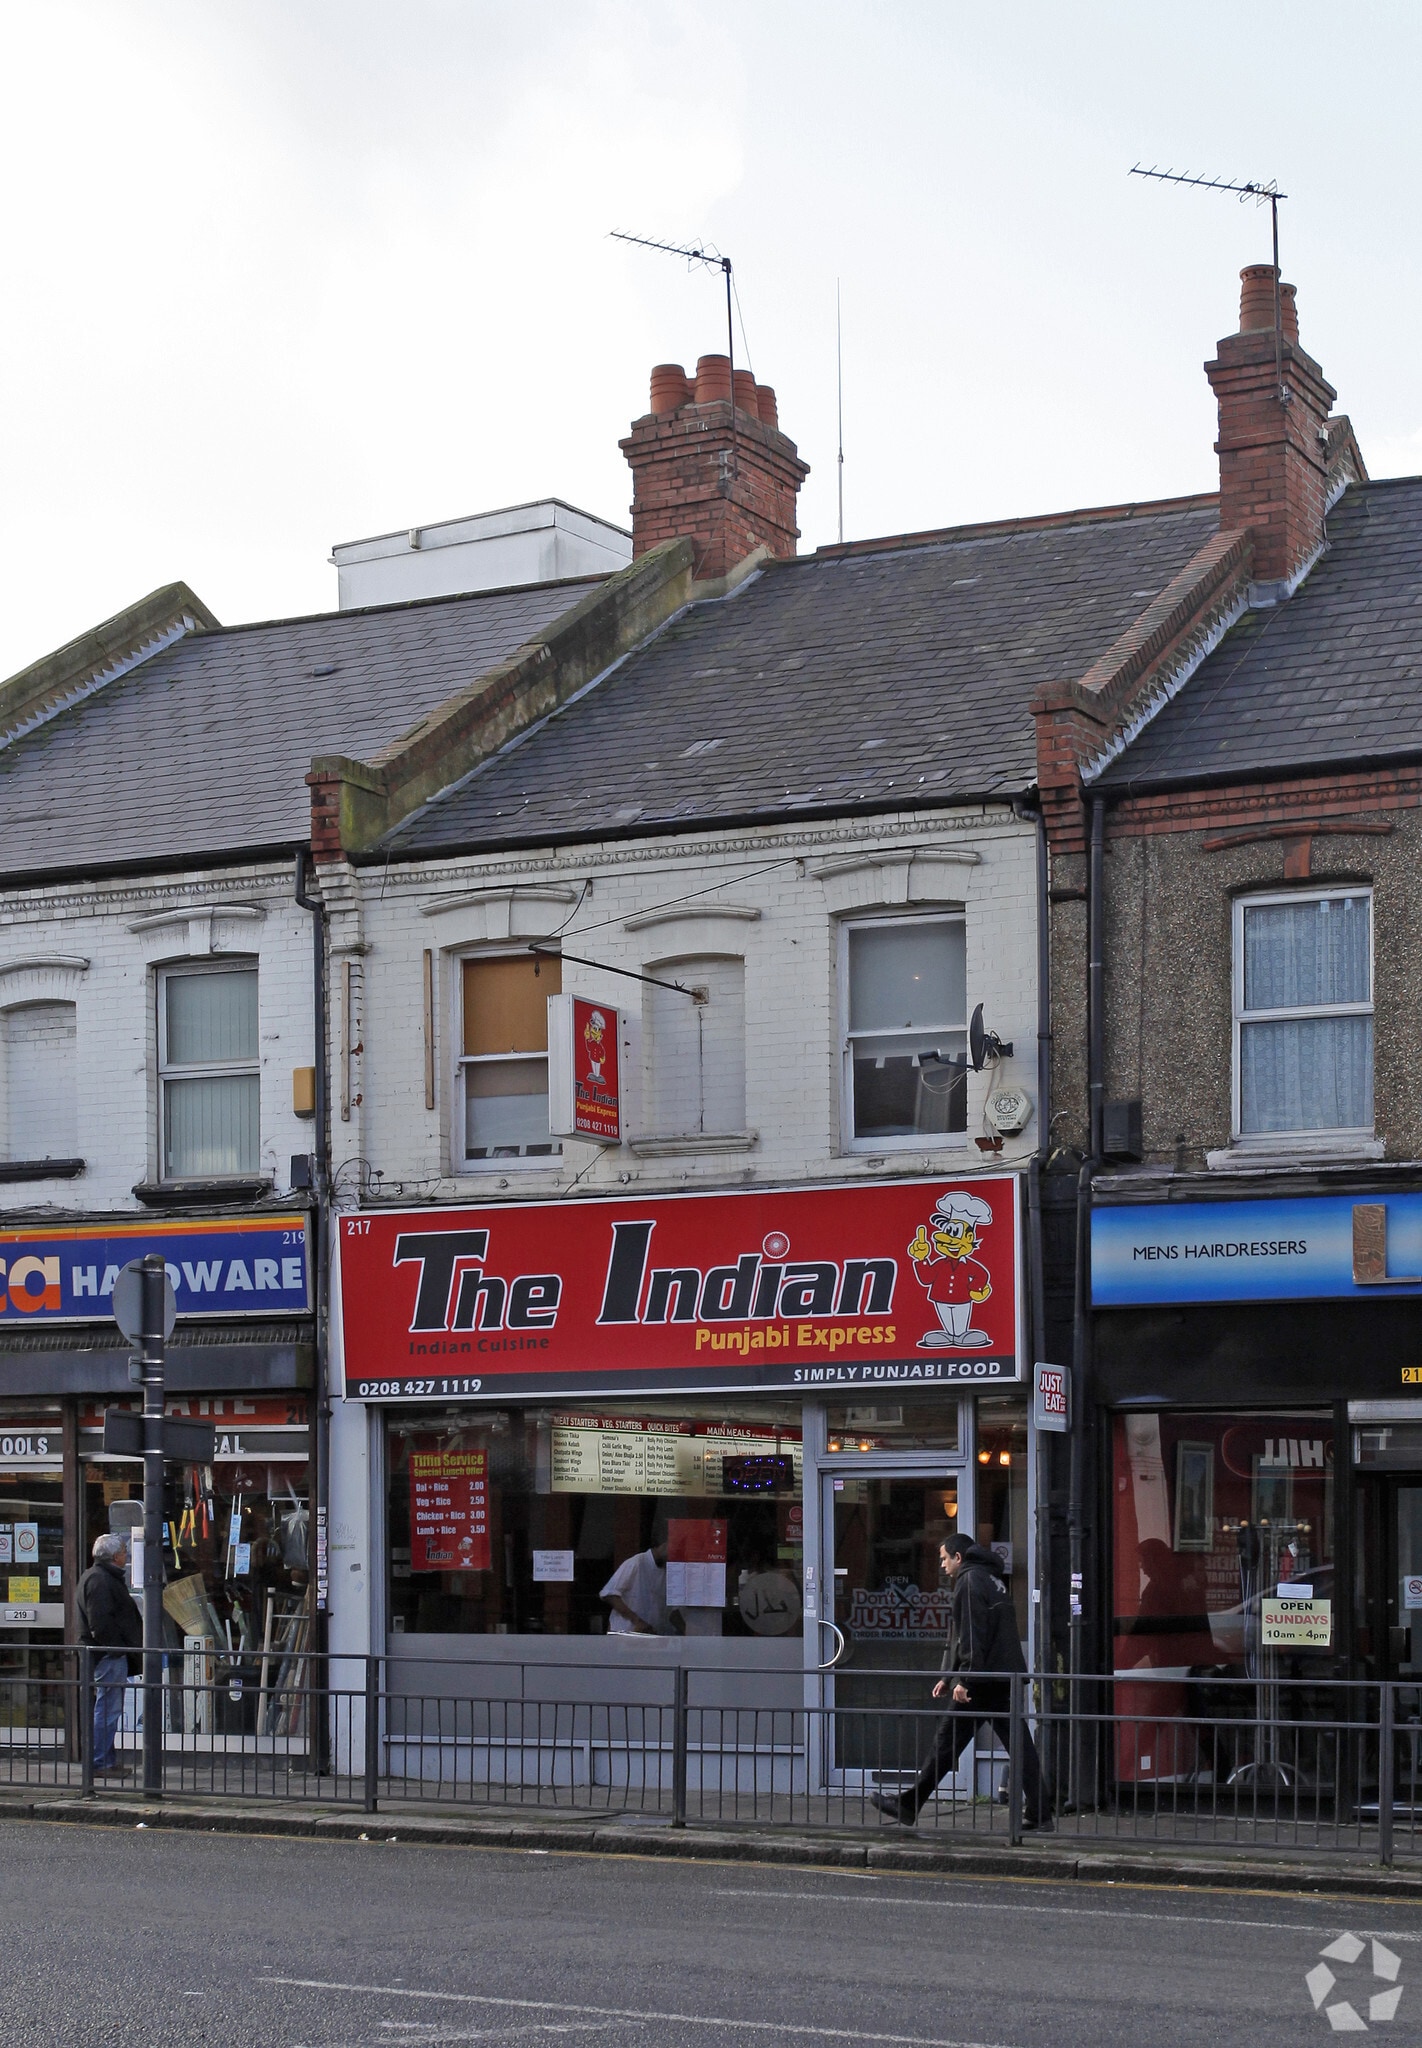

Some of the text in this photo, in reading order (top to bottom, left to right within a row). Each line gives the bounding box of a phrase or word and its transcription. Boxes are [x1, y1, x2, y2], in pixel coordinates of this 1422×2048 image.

[575, 1081, 616, 1105] The Indian
[577, 1102, 616, 1117] Punjabi Express
[577, 1118, 617, 1134] 0208 427 1119
[347, 1221, 371, 1235] 217
[282, 1231, 306, 1245] 219
[1133, 1240, 1307, 1261] MENS HAIRDRESSERS
[393, 1220, 898, 1333] The Indian
[409, 1337, 550, 1355] Indian Cuisine
[695, 1324, 896, 1356] Punjabi Express
[793, 1362, 1001, 1382] SIMPLY PUNJABI FOOD
[359, 1379, 482, 1397] 0208 427 1119
[1040, 1373, 1062, 1392] JUST
[1045, 1393, 1061, 1411] EAT
[554, 1416, 598, 1428] MEAT STARTERS
[602, 1420, 642, 1430] VEG. STARTERS
[647, 1423, 679, 1432] QUICK BITES
[706, 1427, 726, 1435] MAIN
[727, 1429, 751, 1438] MEALS
[0, 1437, 48, 1456] OOLS
[413, 1454, 484, 1467] Tiffin Service
[414, 1467, 484, 1477] Special Lunch Offer
[416, 1483, 427, 1492] Dal
[434, 1483, 449, 1491] Rice
[470, 1482, 484, 1490] 2.00
[416, 1498, 429, 1507] Veg
[436, 1497, 451, 1506] Rice
[470, 1496, 484, 1504] 2.50
[416, 1512, 444, 1521] Chicken
[451, 1511, 466, 1520] Rice
[470, 1511, 485, 1519] 3.00
[417, 1526, 434, 1535] Lamb
[441, 1526, 456, 1534] Rice
[470, 1525, 485, 1534] 3.50
[886, 1576, 908, 1584] OPEN
[856, 1590, 949, 1605] Don't cook
[1280, 1602, 1313, 1610] OPEN
[852, 1608, 948, 1628] JUST EAT
[1265, 1614, 1328, 1625] SUNDAYS
[1266, 1630, 1295, 1638] 10am
[1306, 1630, 1328, 1640] 4pm
